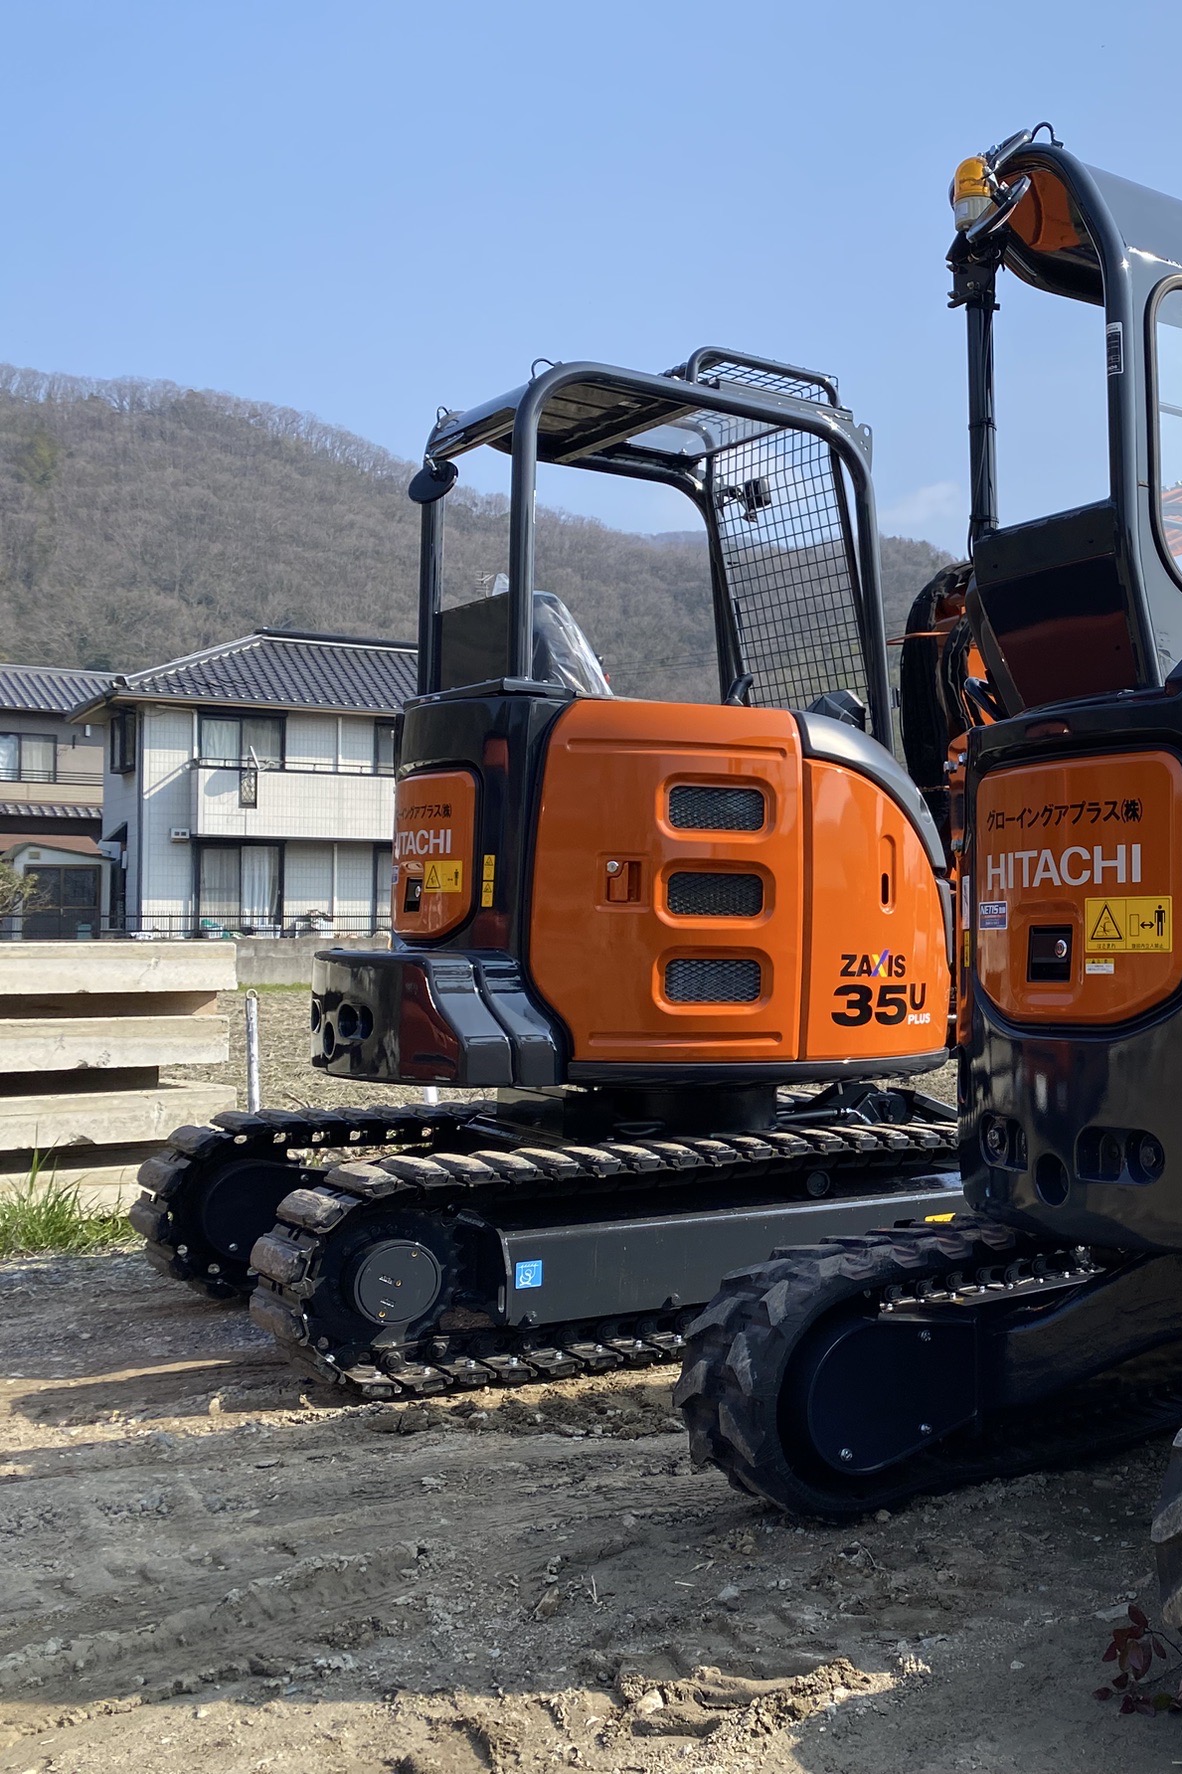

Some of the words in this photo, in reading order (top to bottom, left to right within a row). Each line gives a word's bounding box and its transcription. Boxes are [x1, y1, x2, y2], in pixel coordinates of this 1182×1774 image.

[986, 843, 1142, 891] HITACHI
[840, 949, 906, 978] ZAXIS
[831, 983, 926, 1027] 35U
[907, 1013, 931, 1025] PLUS
